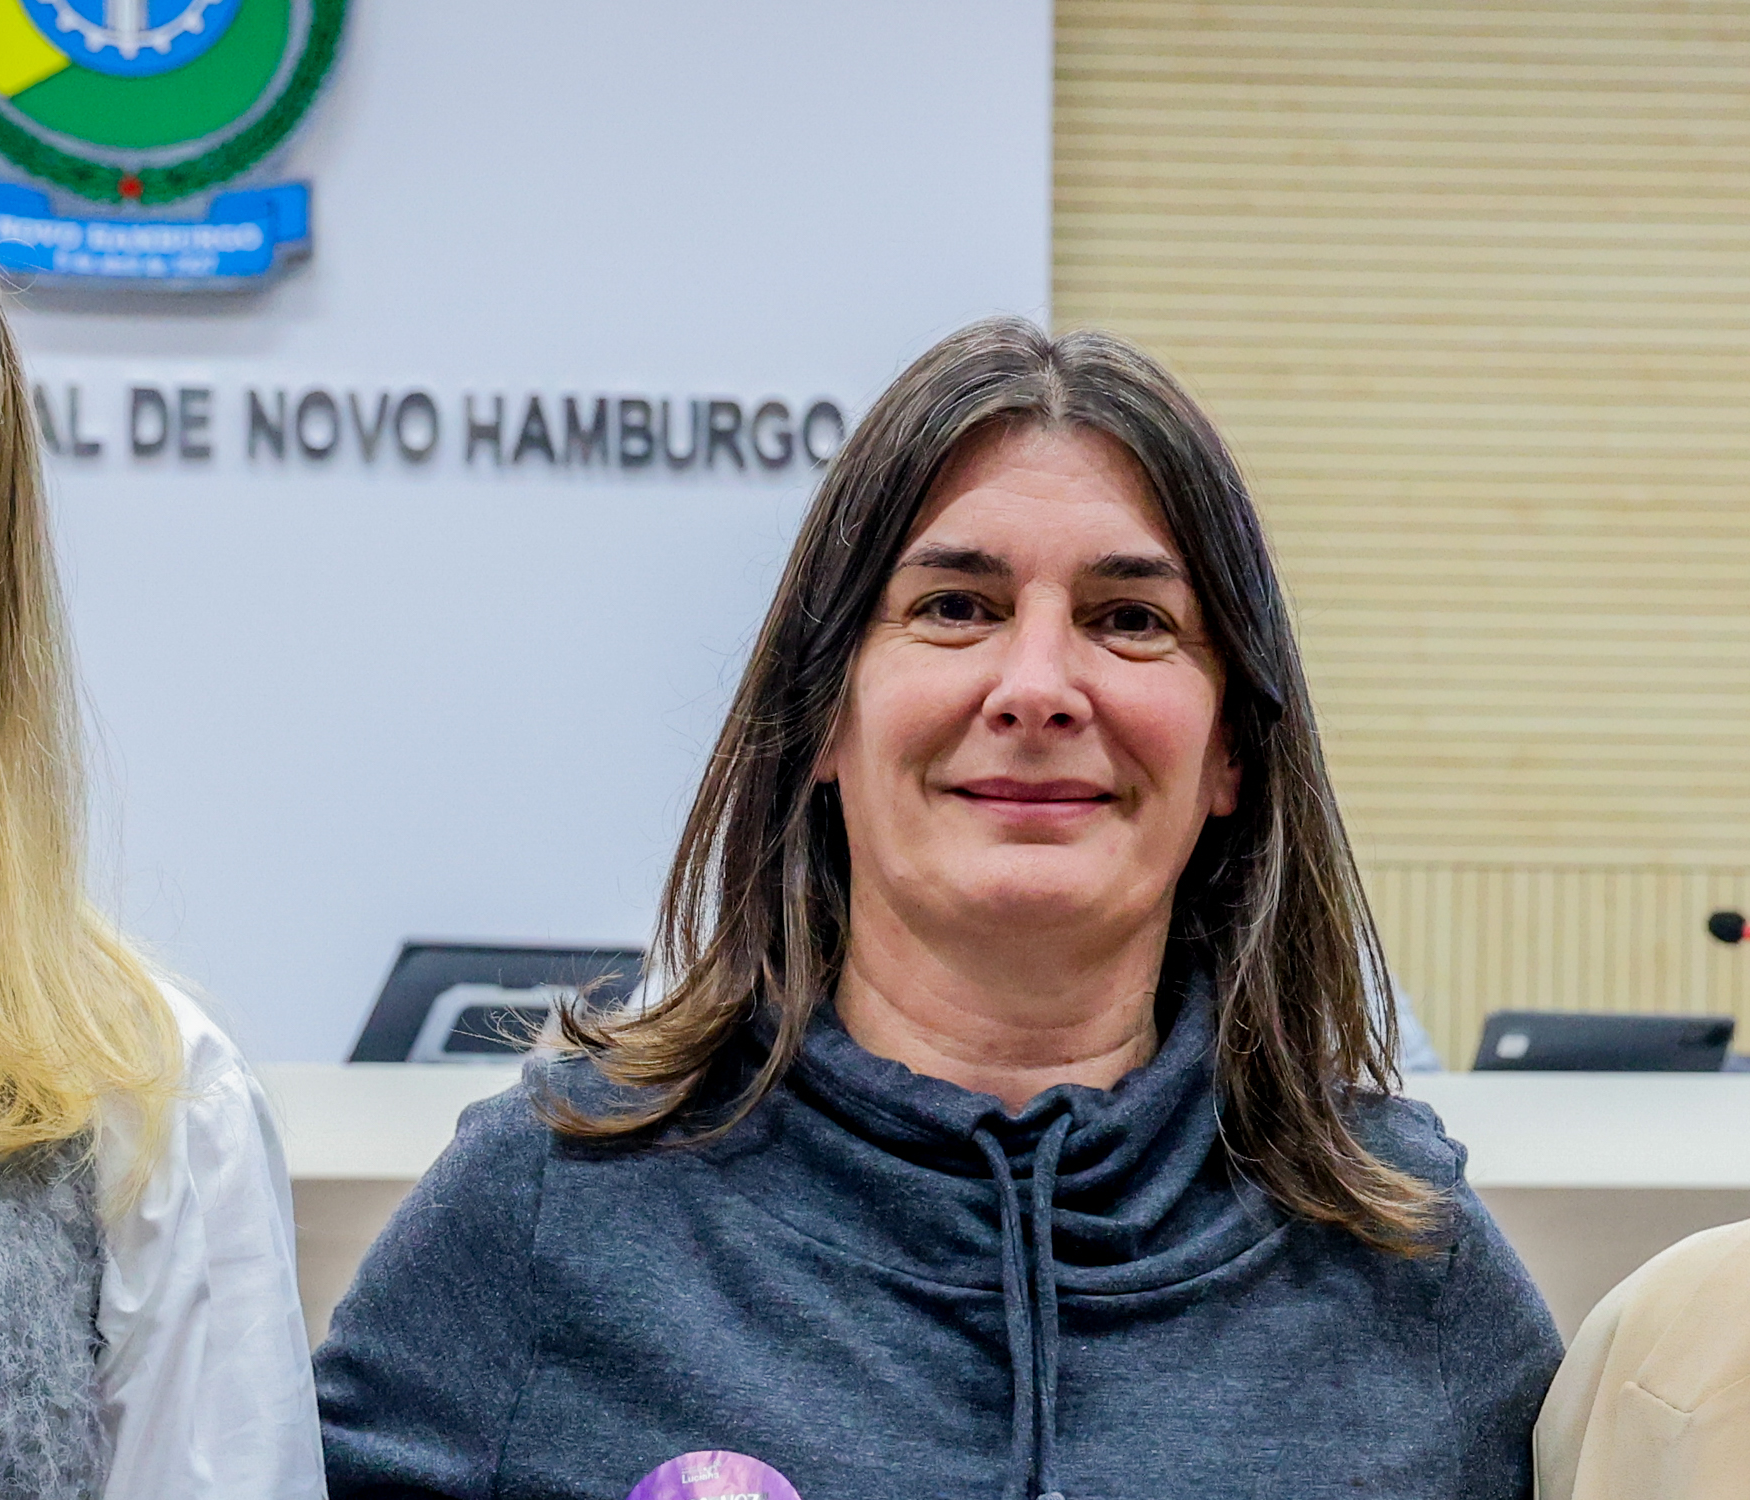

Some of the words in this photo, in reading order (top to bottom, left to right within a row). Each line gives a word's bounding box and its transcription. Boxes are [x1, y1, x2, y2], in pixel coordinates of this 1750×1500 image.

[128, 385, 212, 460] DE
[246, 388, 439, 463] NOVO
[464, 393, 845, 469] HAMBURGO
